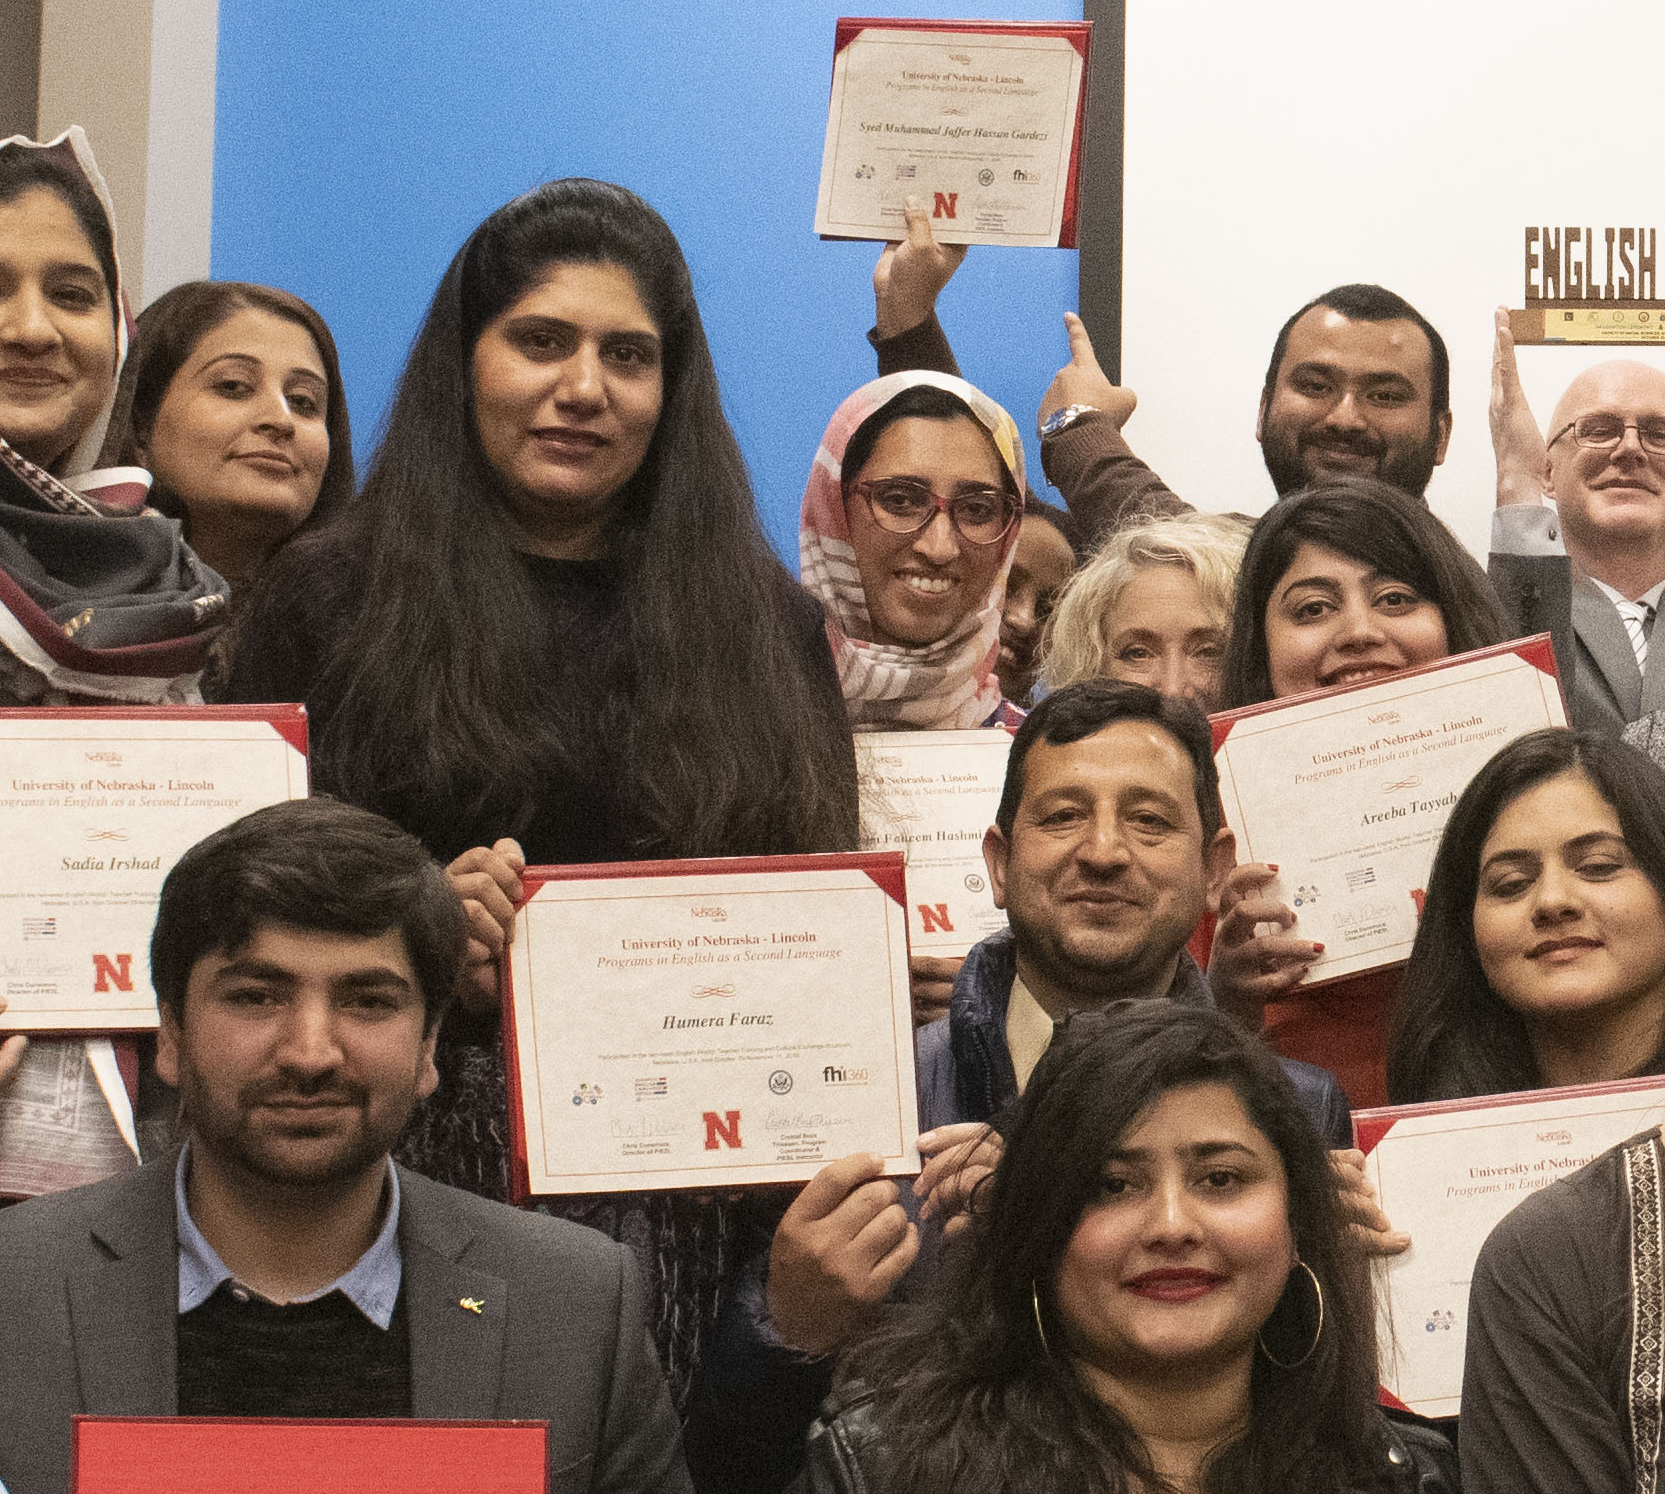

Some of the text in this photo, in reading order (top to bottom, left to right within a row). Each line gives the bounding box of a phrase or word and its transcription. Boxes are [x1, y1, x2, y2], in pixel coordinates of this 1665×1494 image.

[932, 192, 959, 219] N
[1525, 227, 1655, 299] ENGLISH
[1312, 716, 1483, 765] University of Nebraska Lincoln
[12, 779, 214, 793] University of Nebraska Lincoln
[1360, 792, 1458, 827] Areeba Tayyab
[61, 857, 161, 871] Sadia Irshad
[917, 904, 954, 933] N
[622, 932, 816, 951] University of Nebraska Lincoln
[92, 953, 133, 993] N
[662, 1012, 773, 1030] Humera Faraz
[703, 1110, 742, 1150] N
[1469, 1163, 1530, 1179] University
[1534, 1160, 1545, 1170] of
